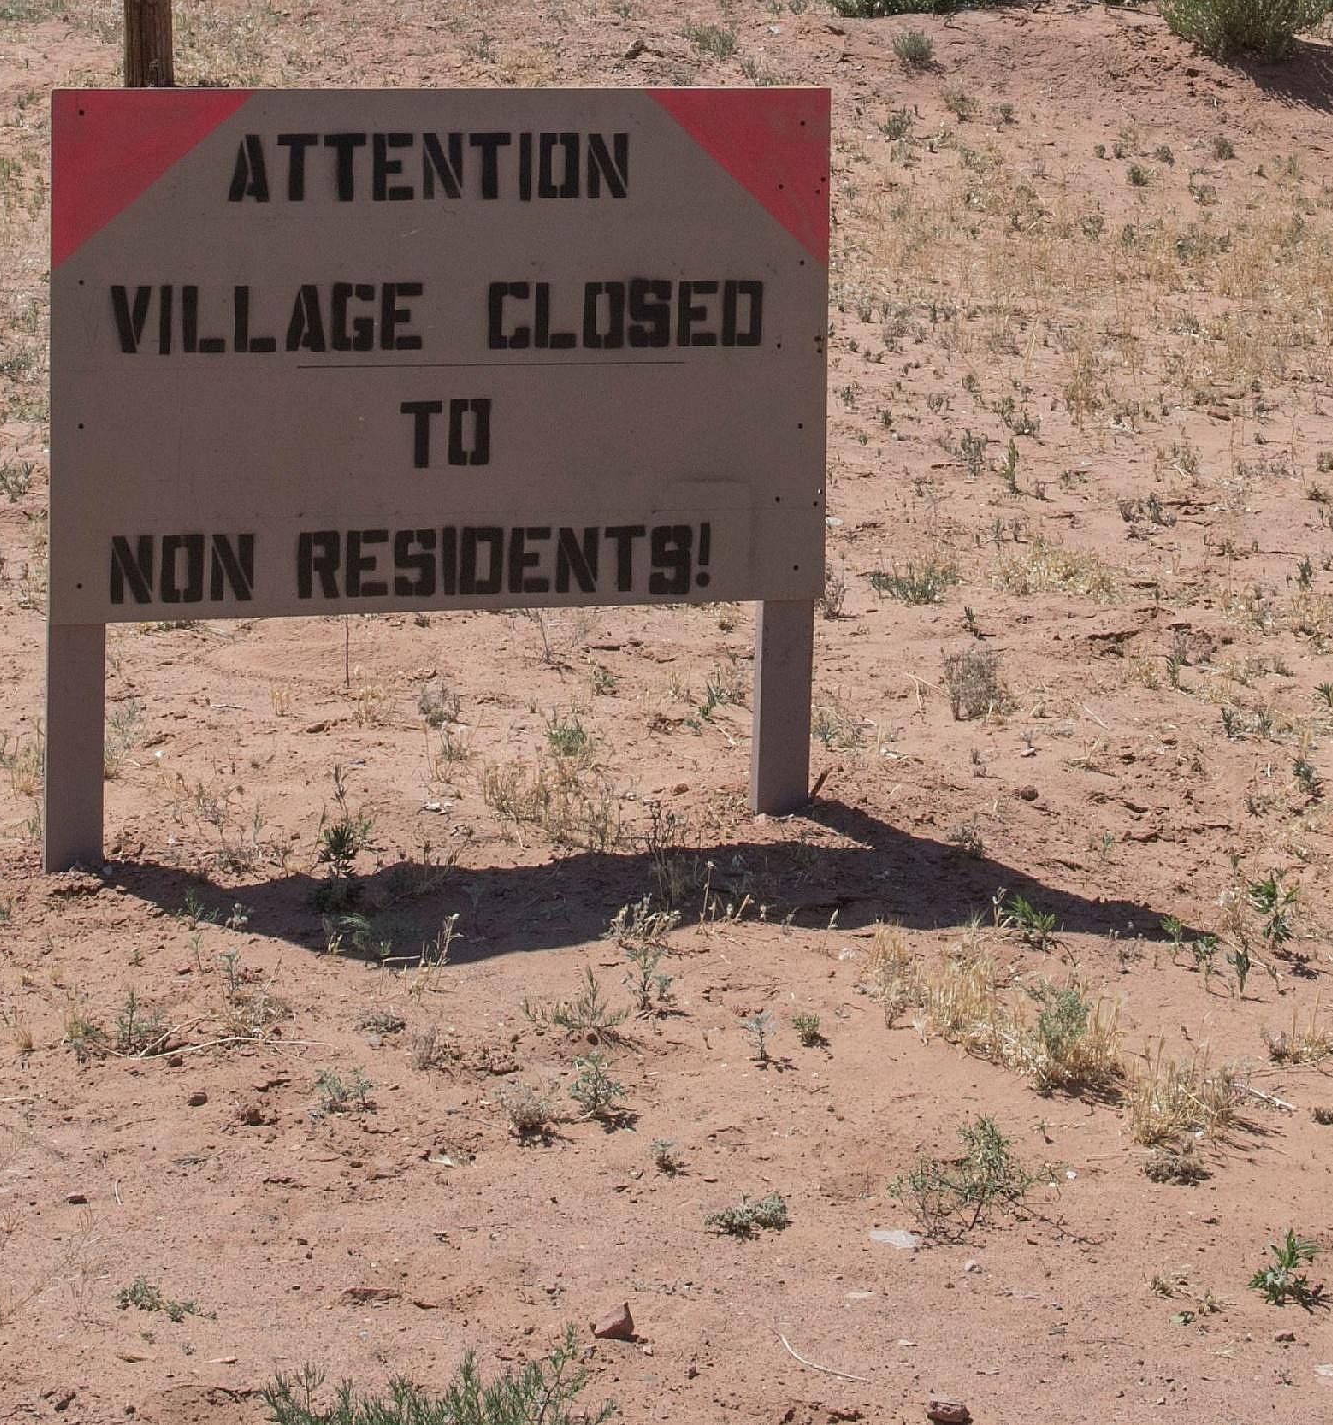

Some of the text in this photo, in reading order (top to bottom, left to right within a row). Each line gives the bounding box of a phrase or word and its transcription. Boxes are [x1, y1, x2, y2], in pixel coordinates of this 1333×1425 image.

[228, 131, 630, 203] ATTENTION
[110, 277, 764, 355] VILLAGE CLOSED
[399, 397, 493, 470] TO
[110, 522, 712, 606] NON RESIDENTS!
